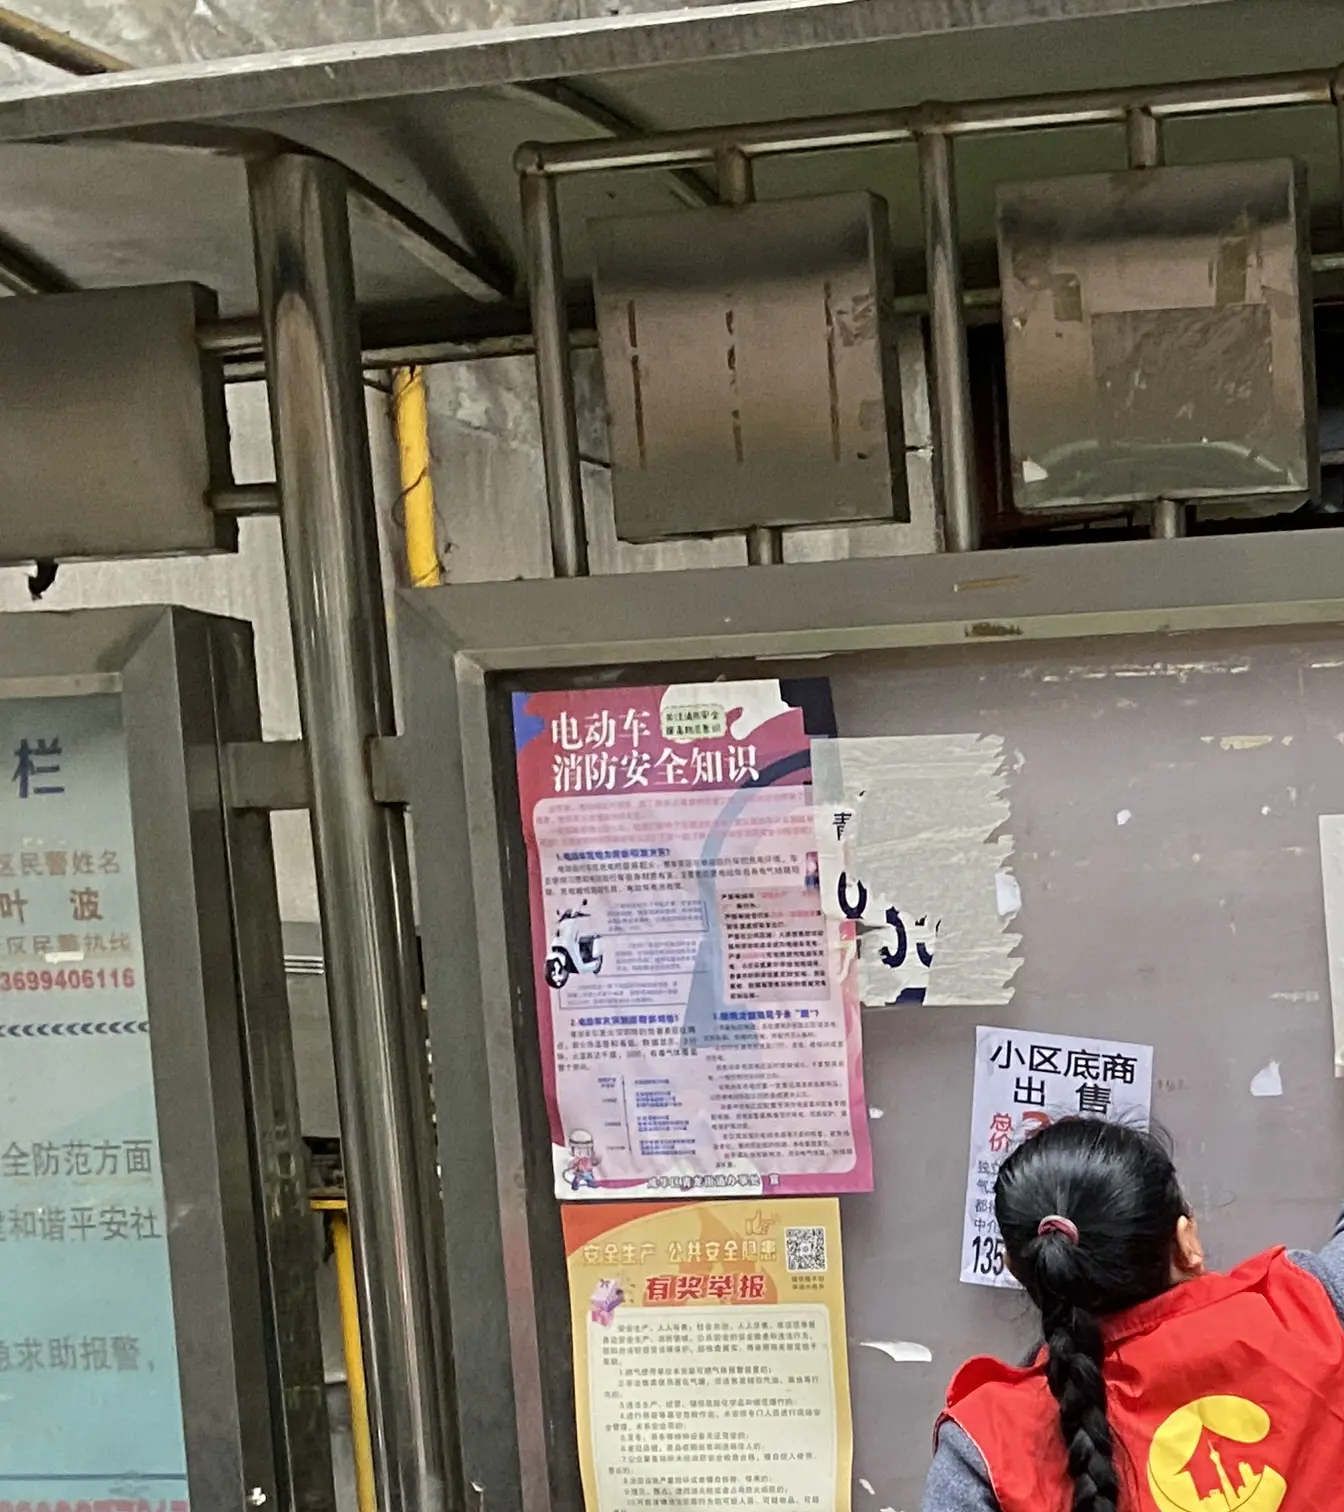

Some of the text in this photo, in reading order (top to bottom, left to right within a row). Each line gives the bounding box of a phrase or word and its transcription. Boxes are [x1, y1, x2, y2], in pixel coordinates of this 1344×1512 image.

[551, 707, 651, 750] 电动车
[12, 736, 65, 798] 栏
[552, 744, 760, 793] 消防安全知识
[990, 1040, 1138, 1085] 小区底商
[1013, 1075, 1112, 1116] 出售
[989, 1112, 1015, 1153] 总价
[1, 1138, 153, 1178] 全防范方面
[0, 1205, 162, 1242] 和谐平安社
[583, 1239, 778, 1266] 安全生产 公共安全隐患
[645, 1274, 765, 1301] 有奖举报
